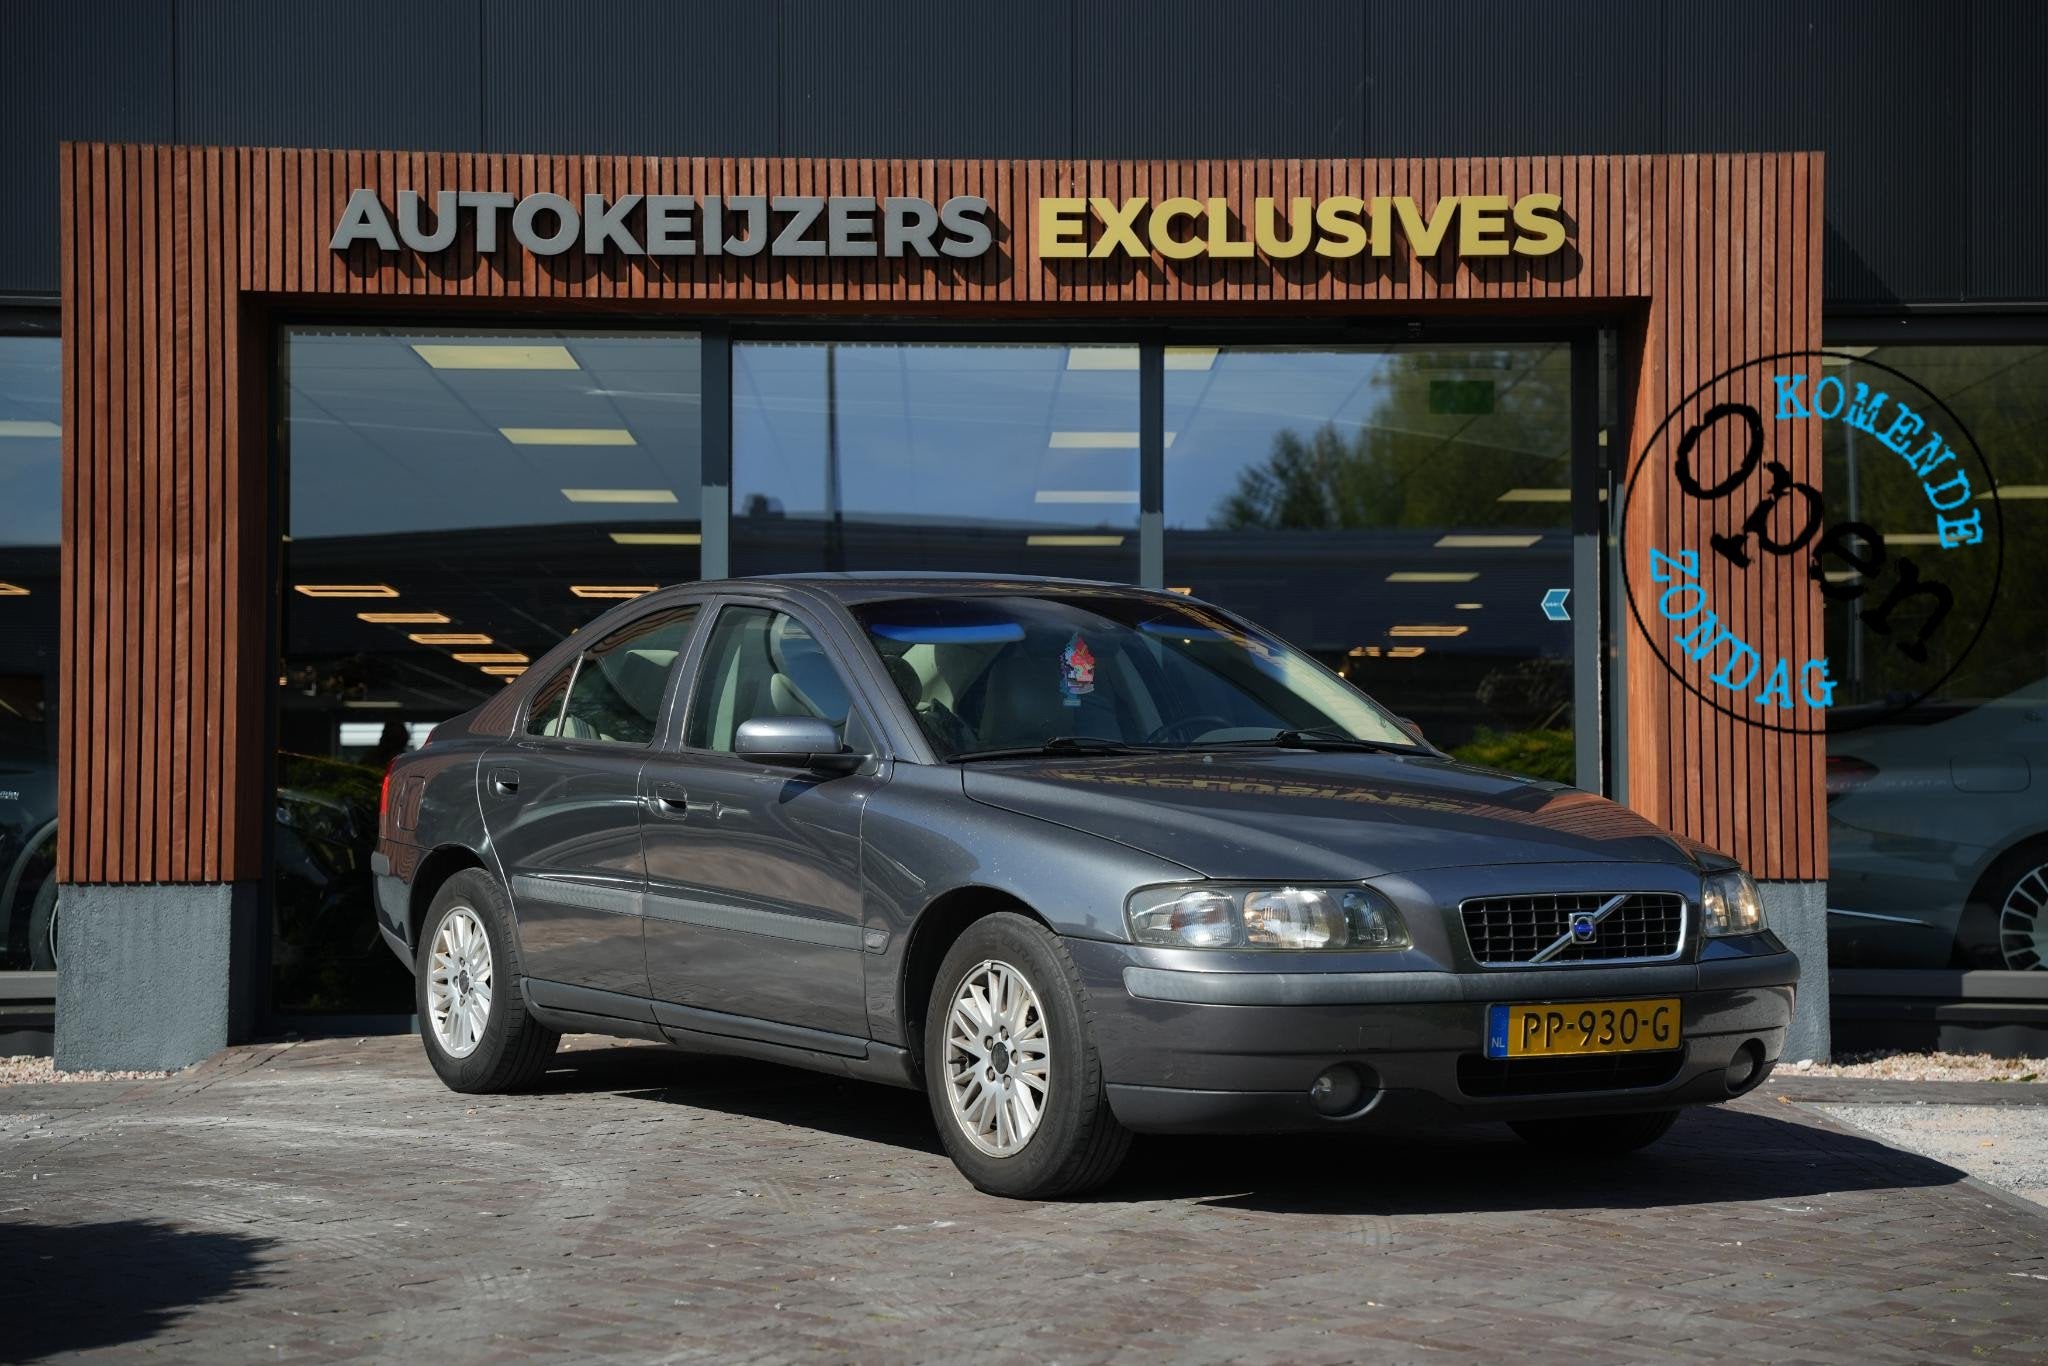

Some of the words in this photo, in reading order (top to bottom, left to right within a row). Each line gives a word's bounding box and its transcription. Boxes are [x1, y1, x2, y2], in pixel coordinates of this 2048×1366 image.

[329, 188, 993, 258] AUTOKEIJZERS
[1039, 193, 1566, 260] EXCLUSIVES
[1491, 1036, 1505, 1048] NL
[1522, 1006, 1669, 1049] PP-930-G
